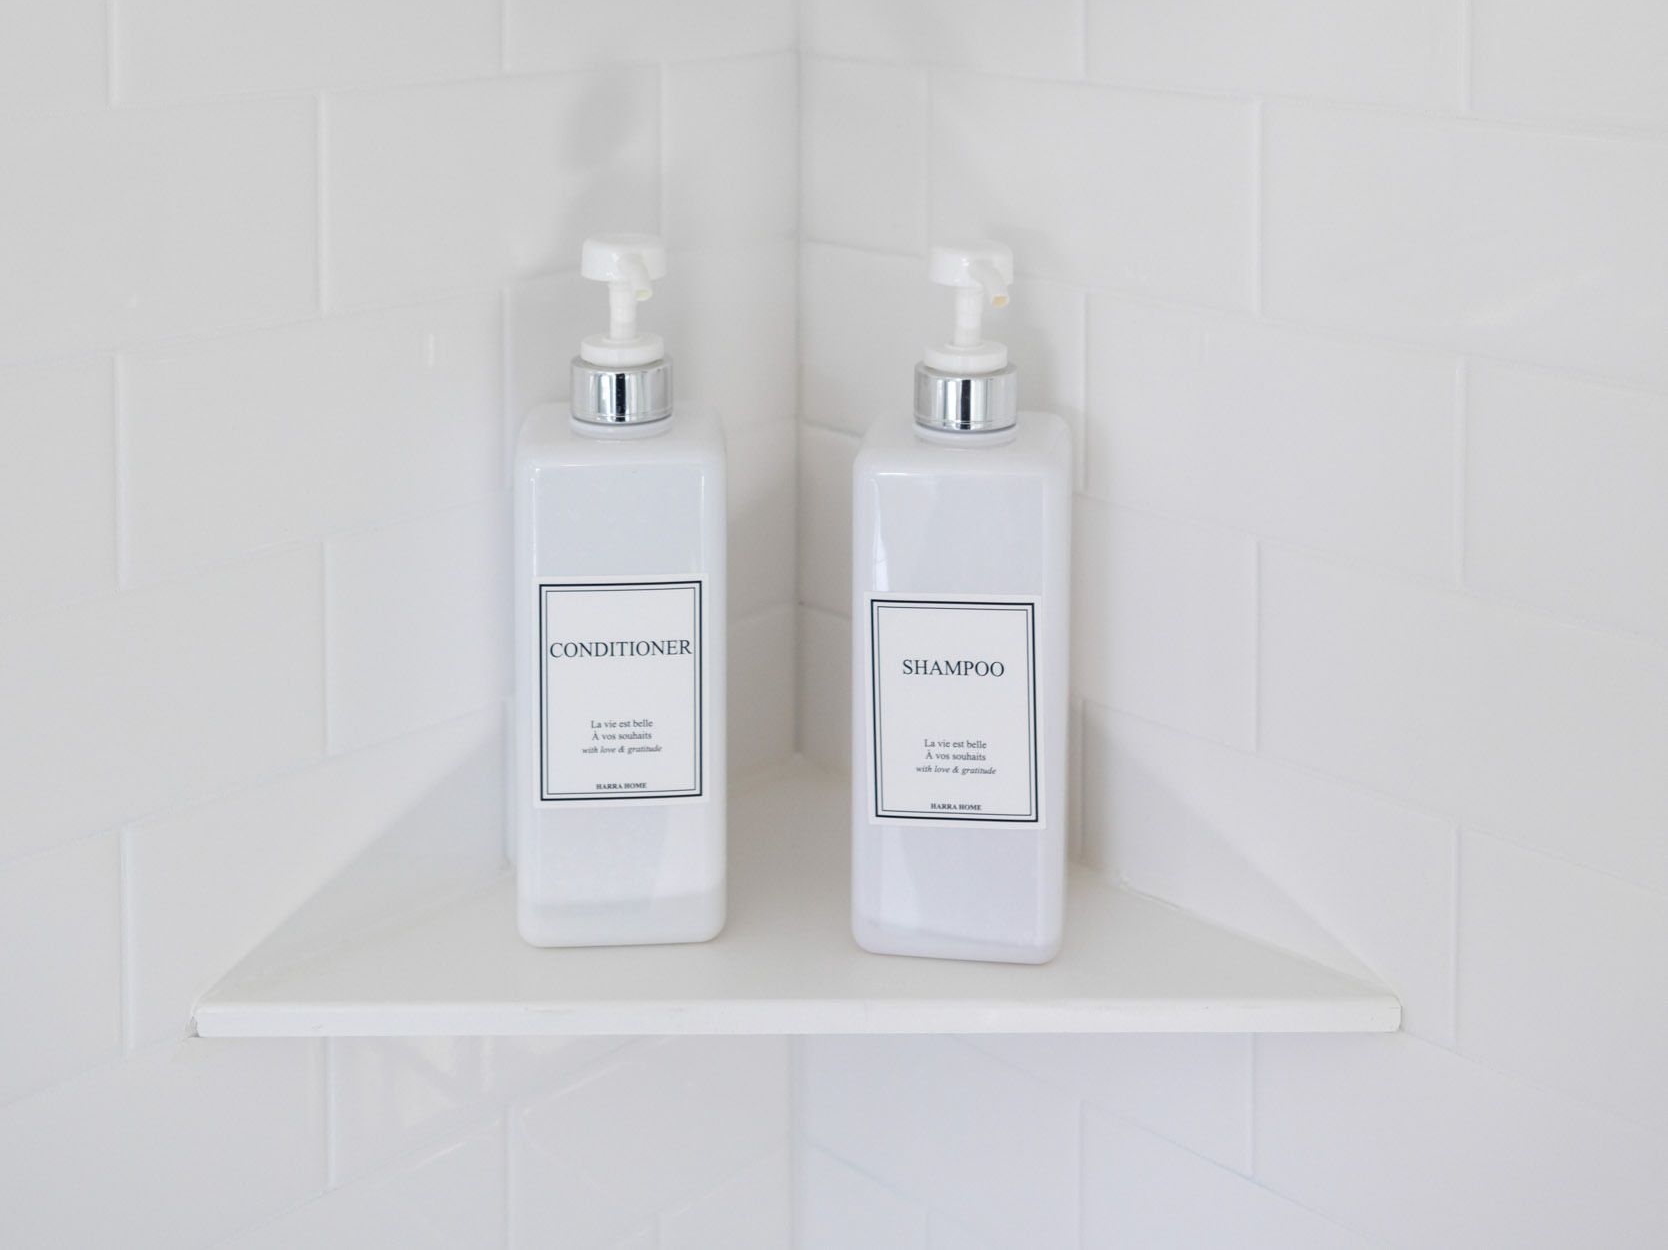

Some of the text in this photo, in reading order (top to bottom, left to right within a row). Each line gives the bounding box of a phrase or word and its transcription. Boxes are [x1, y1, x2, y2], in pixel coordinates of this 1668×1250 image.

[550, 639, 692, 658] CONDITIONER
[903, 659, 1004, 677] SHAMPOO
[591, 719, 653, 729] La vie est belle
[592, 731, 599, 741] À
[619, 732, 652, 740] souhaits
[924, 739, 987, 749] La vie est belle
[582, 745, 662, 755] with love & gratitude
[926, 750, 933, 760] À
[952, 752, 986, 761] souhaits
[916, 765, 932, 773] with
[952, 766, 959, 774] &
[962, 766, 996, 775] gratitude
